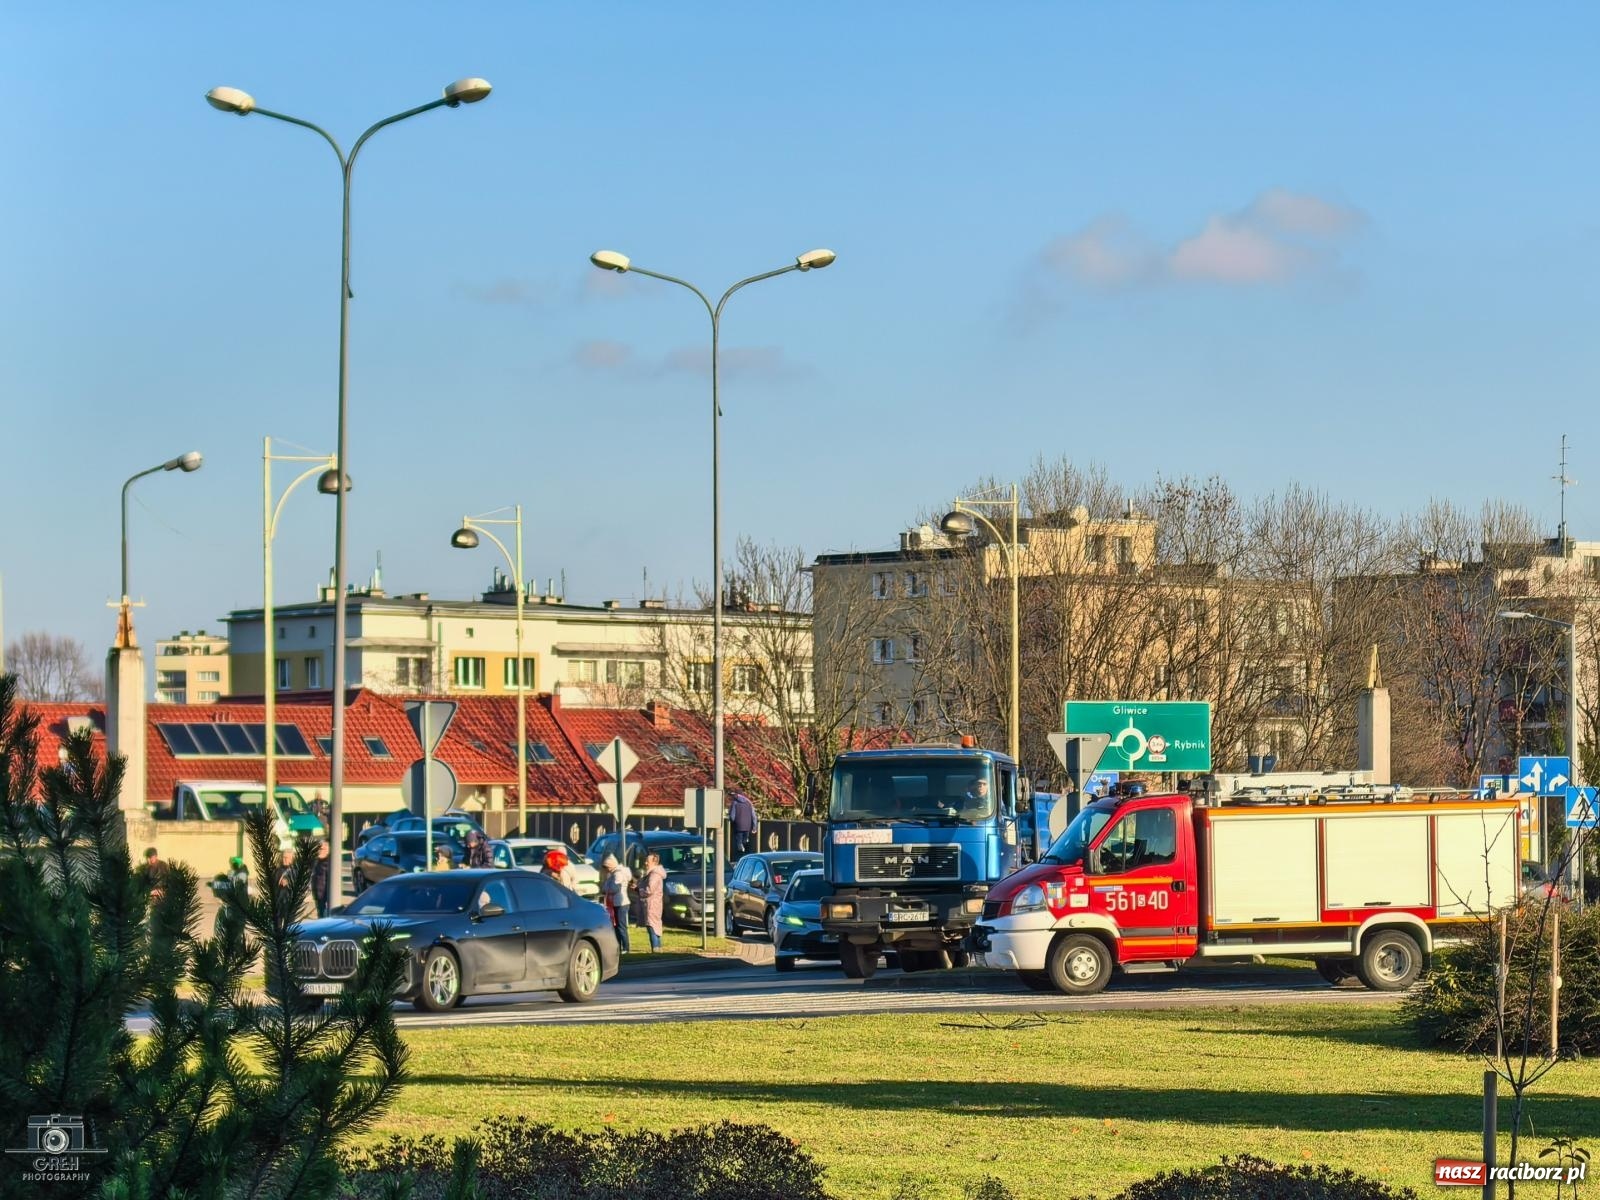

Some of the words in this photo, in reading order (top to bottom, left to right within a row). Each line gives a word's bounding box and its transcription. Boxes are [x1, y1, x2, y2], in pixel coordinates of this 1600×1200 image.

[1113, 705, 1148, 715] Gliwice
[1174, 740, 1206, 751] Rybnik
[885, 856, 929, 864] MAN
